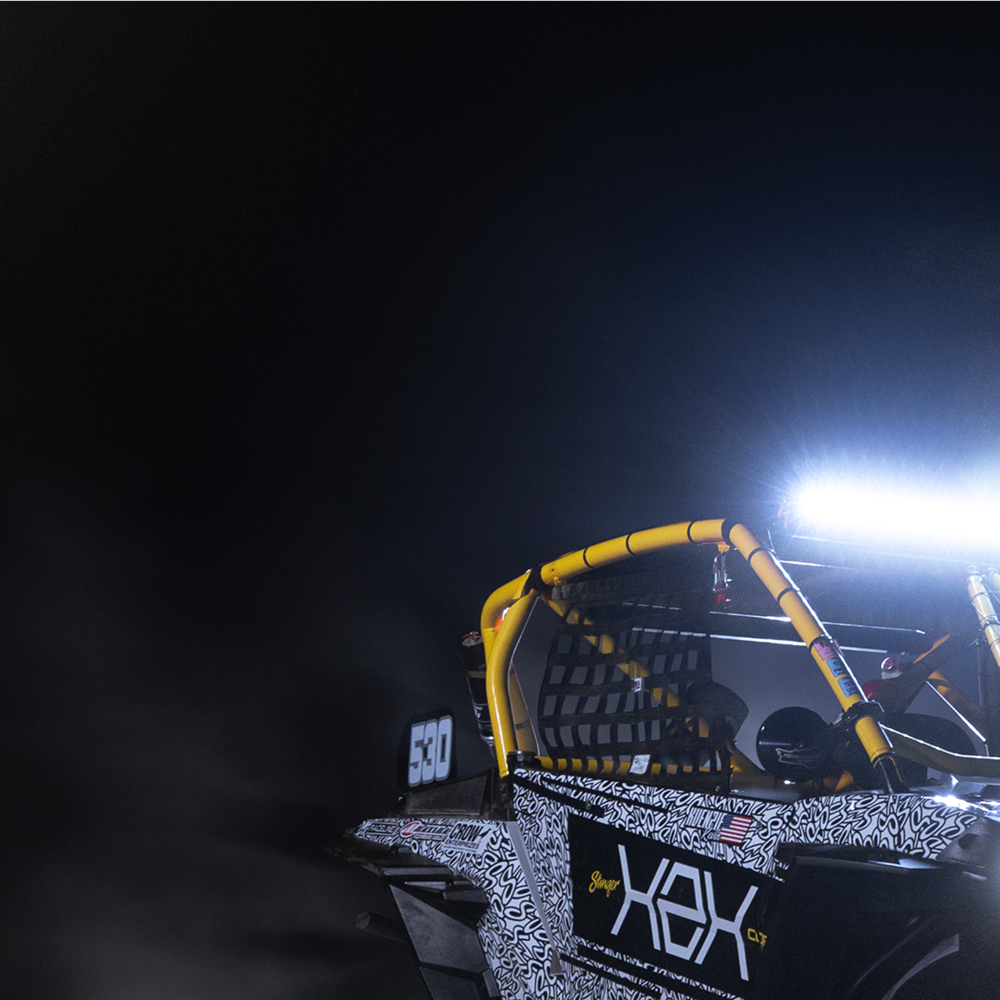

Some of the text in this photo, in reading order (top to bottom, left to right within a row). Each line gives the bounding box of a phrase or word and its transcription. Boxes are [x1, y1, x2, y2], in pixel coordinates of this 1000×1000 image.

[408, 715, 453, 787] 530
[449, 823, 482, 841] CROW
[589, 871, 620, 897] Stinger
